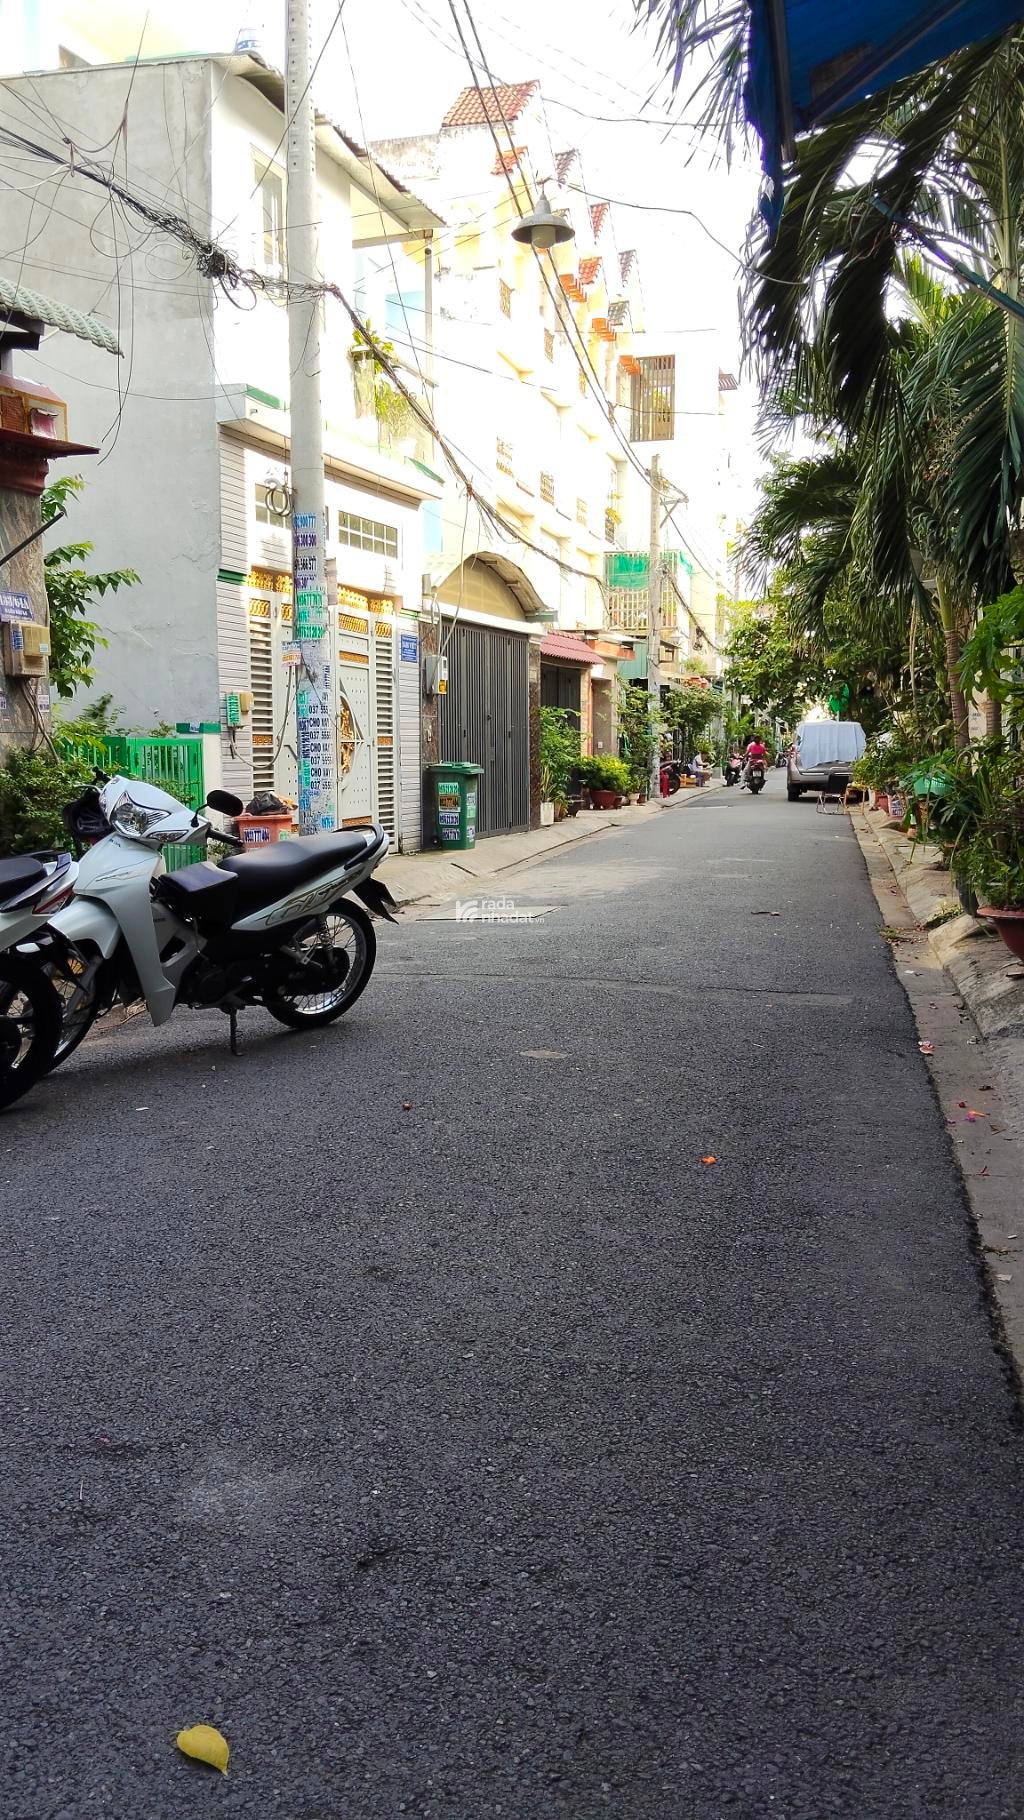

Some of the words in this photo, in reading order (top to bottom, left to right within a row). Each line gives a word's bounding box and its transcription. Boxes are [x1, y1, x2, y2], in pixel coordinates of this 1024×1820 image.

[309, 717, 320, 728] CHO
[310, 743, 321, 754] CHO
[310, 767, 322, 778] CHO
